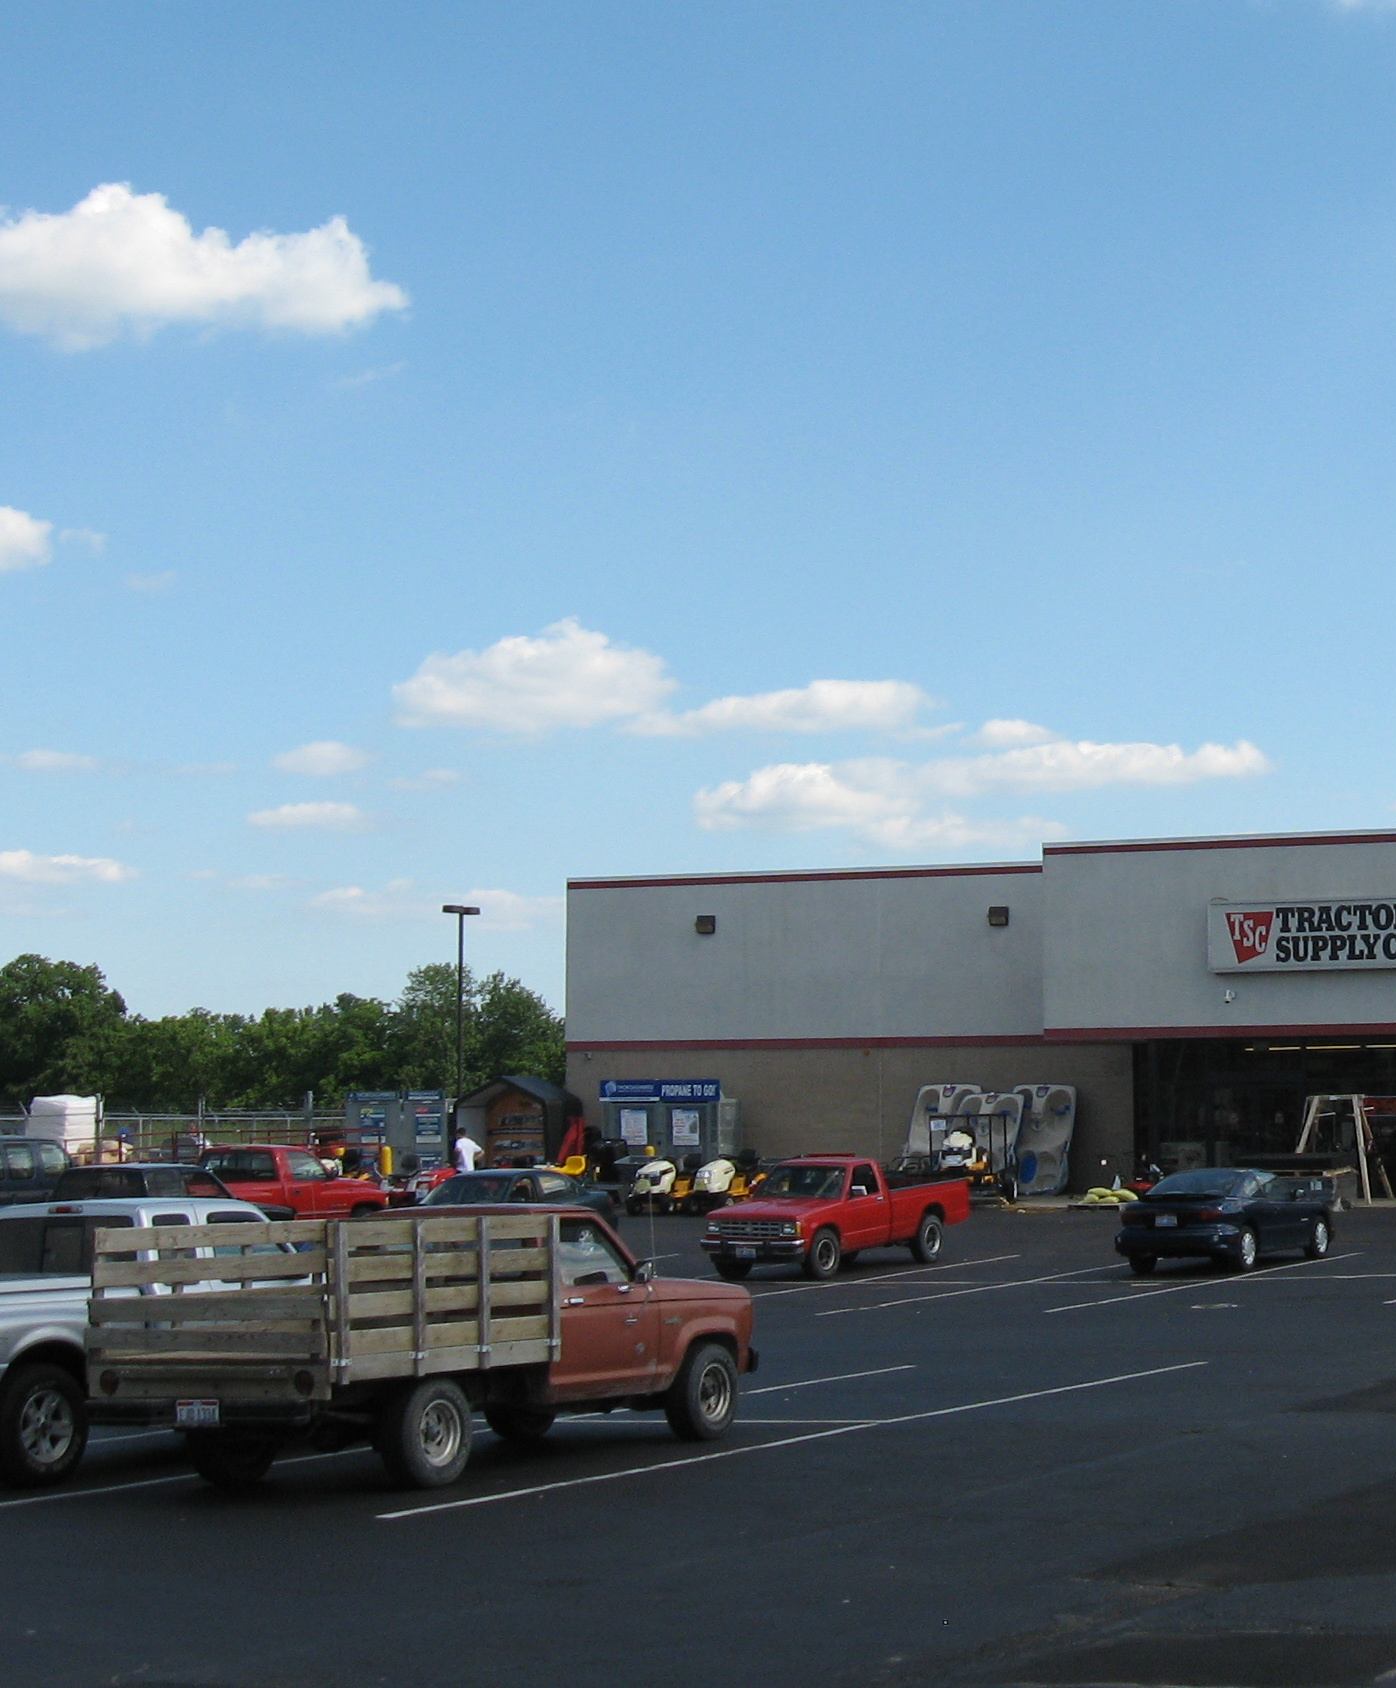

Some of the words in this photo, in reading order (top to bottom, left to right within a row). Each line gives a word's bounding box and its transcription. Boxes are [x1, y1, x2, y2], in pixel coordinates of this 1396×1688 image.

[1230, 913, 1267, 952] TSC
[1276, 934, 1380, 963] SUPPLY
[661, 1084, 691, 1097] PROPANE
[693, 1084, 702, 1096] TO
